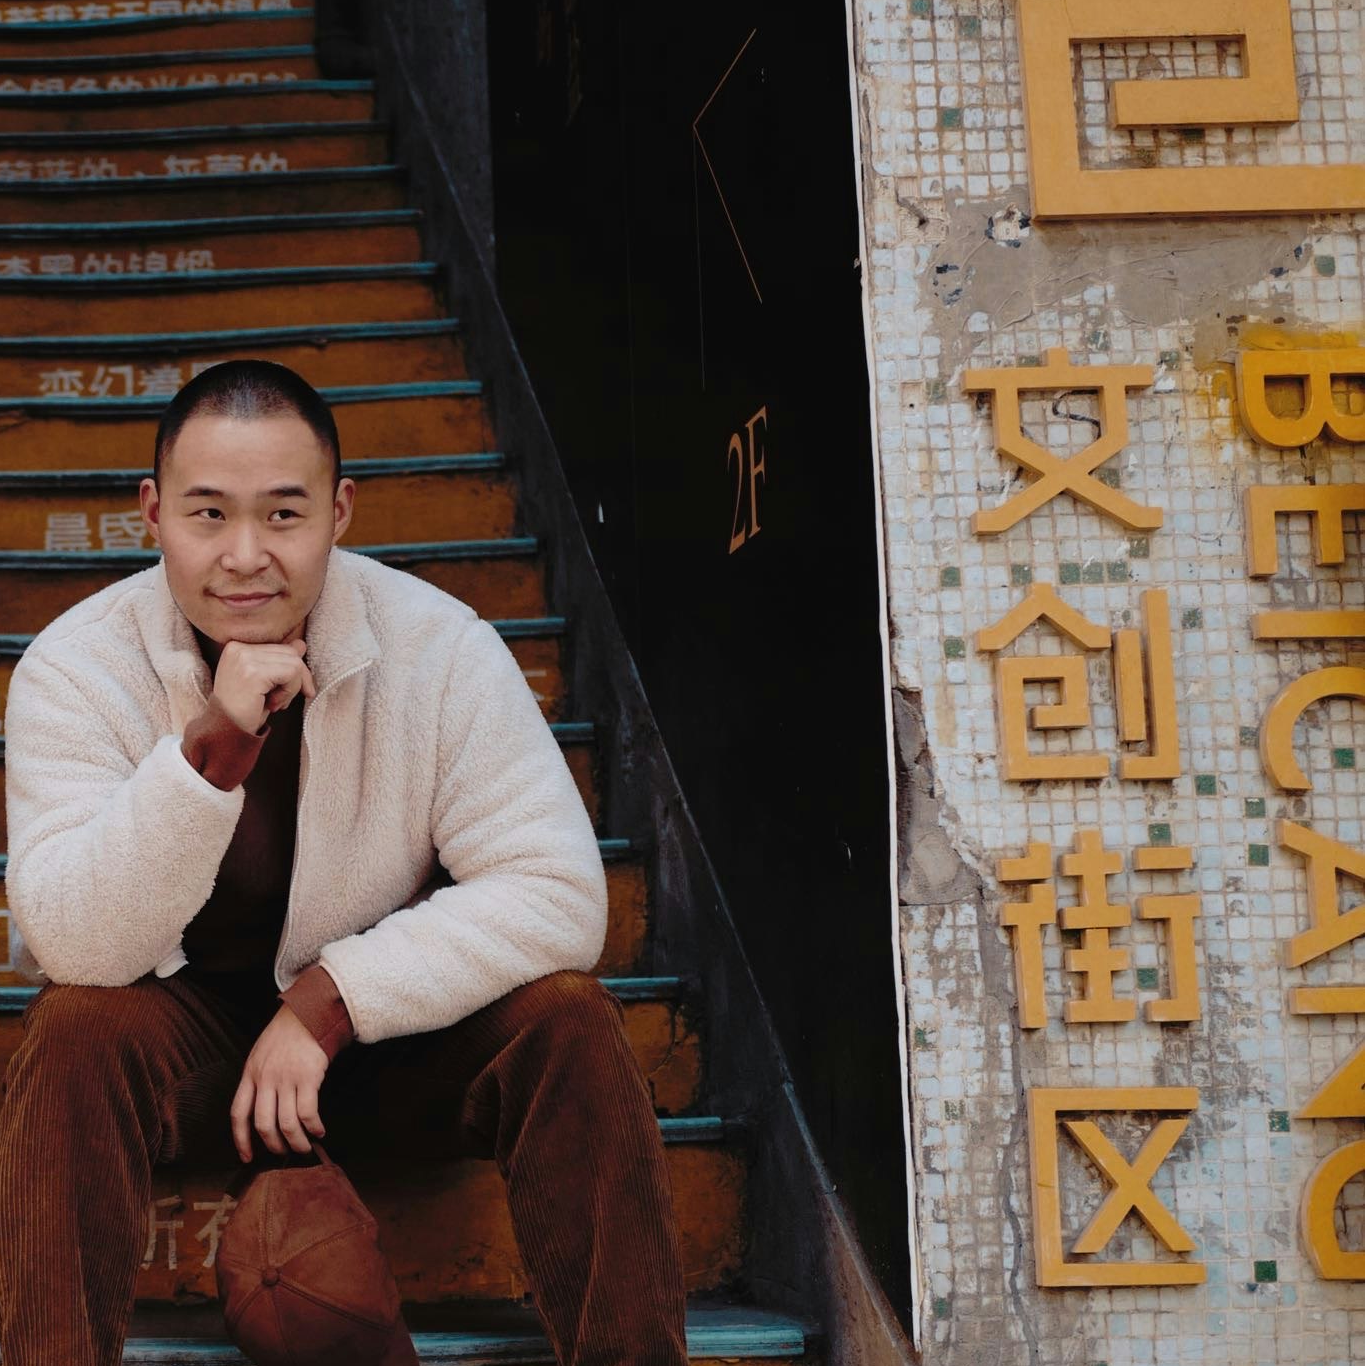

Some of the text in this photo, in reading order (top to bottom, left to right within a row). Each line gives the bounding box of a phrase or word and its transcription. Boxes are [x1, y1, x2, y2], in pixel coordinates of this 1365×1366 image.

[38, 361, 225, 398] 变幻着
[727, 405, 767, 555] 2F
[961, 347, 1208, 1288] 文创街区
